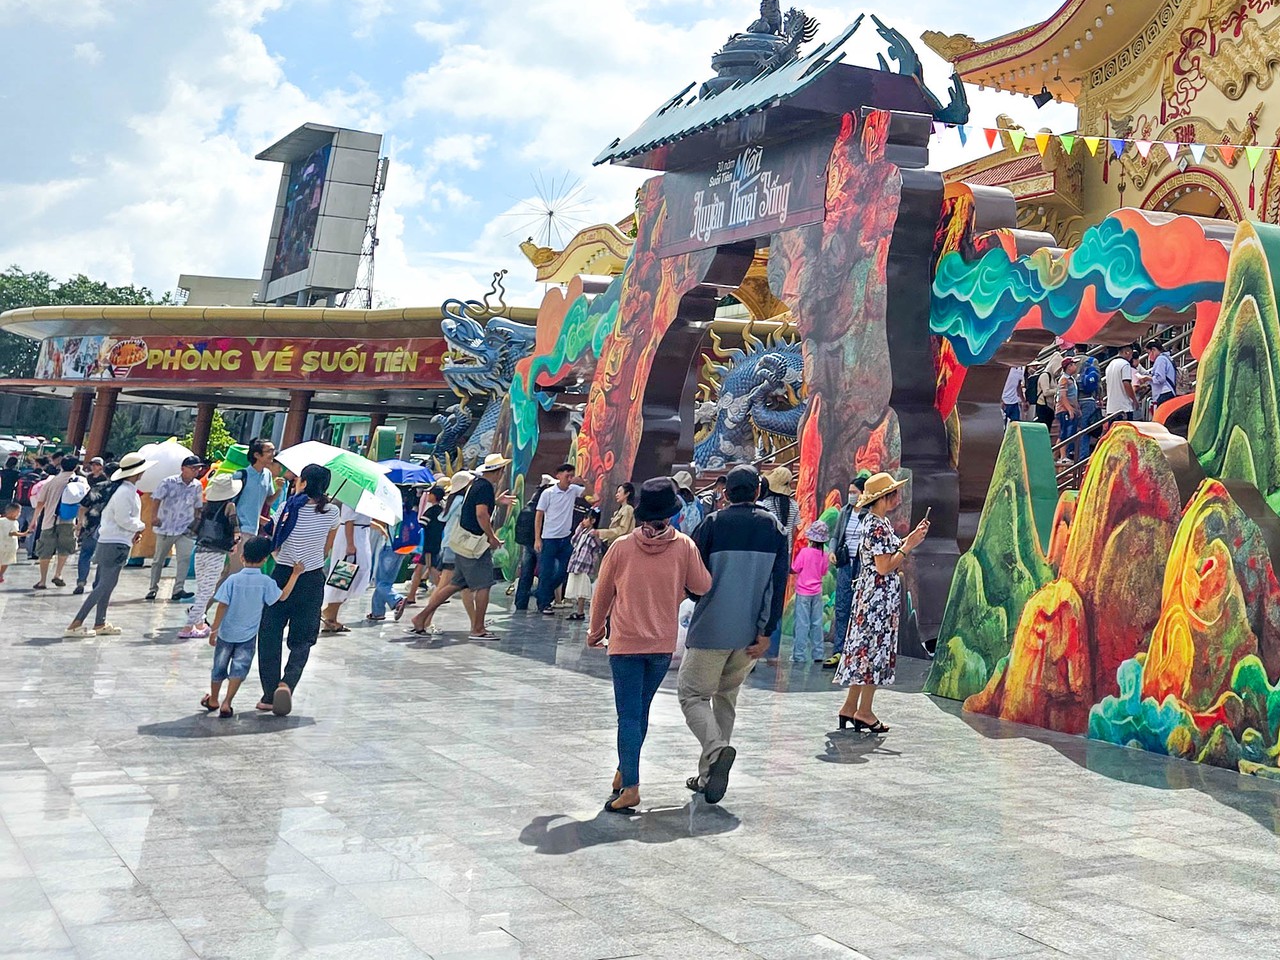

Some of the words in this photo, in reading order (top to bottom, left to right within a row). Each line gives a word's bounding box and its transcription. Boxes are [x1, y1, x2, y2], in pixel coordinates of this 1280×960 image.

[690, 190, 725, 242] Huyền
[728, 180, 758, 226] Thoại
[759, 171, 792, 224] Sống
[146, 343, 243, 370] PHÒNG
[251, 345, 294, 372] VÉ
[300, 343, 367, 373] SUỐI
[373, 346, 419, 373] TIÊN
